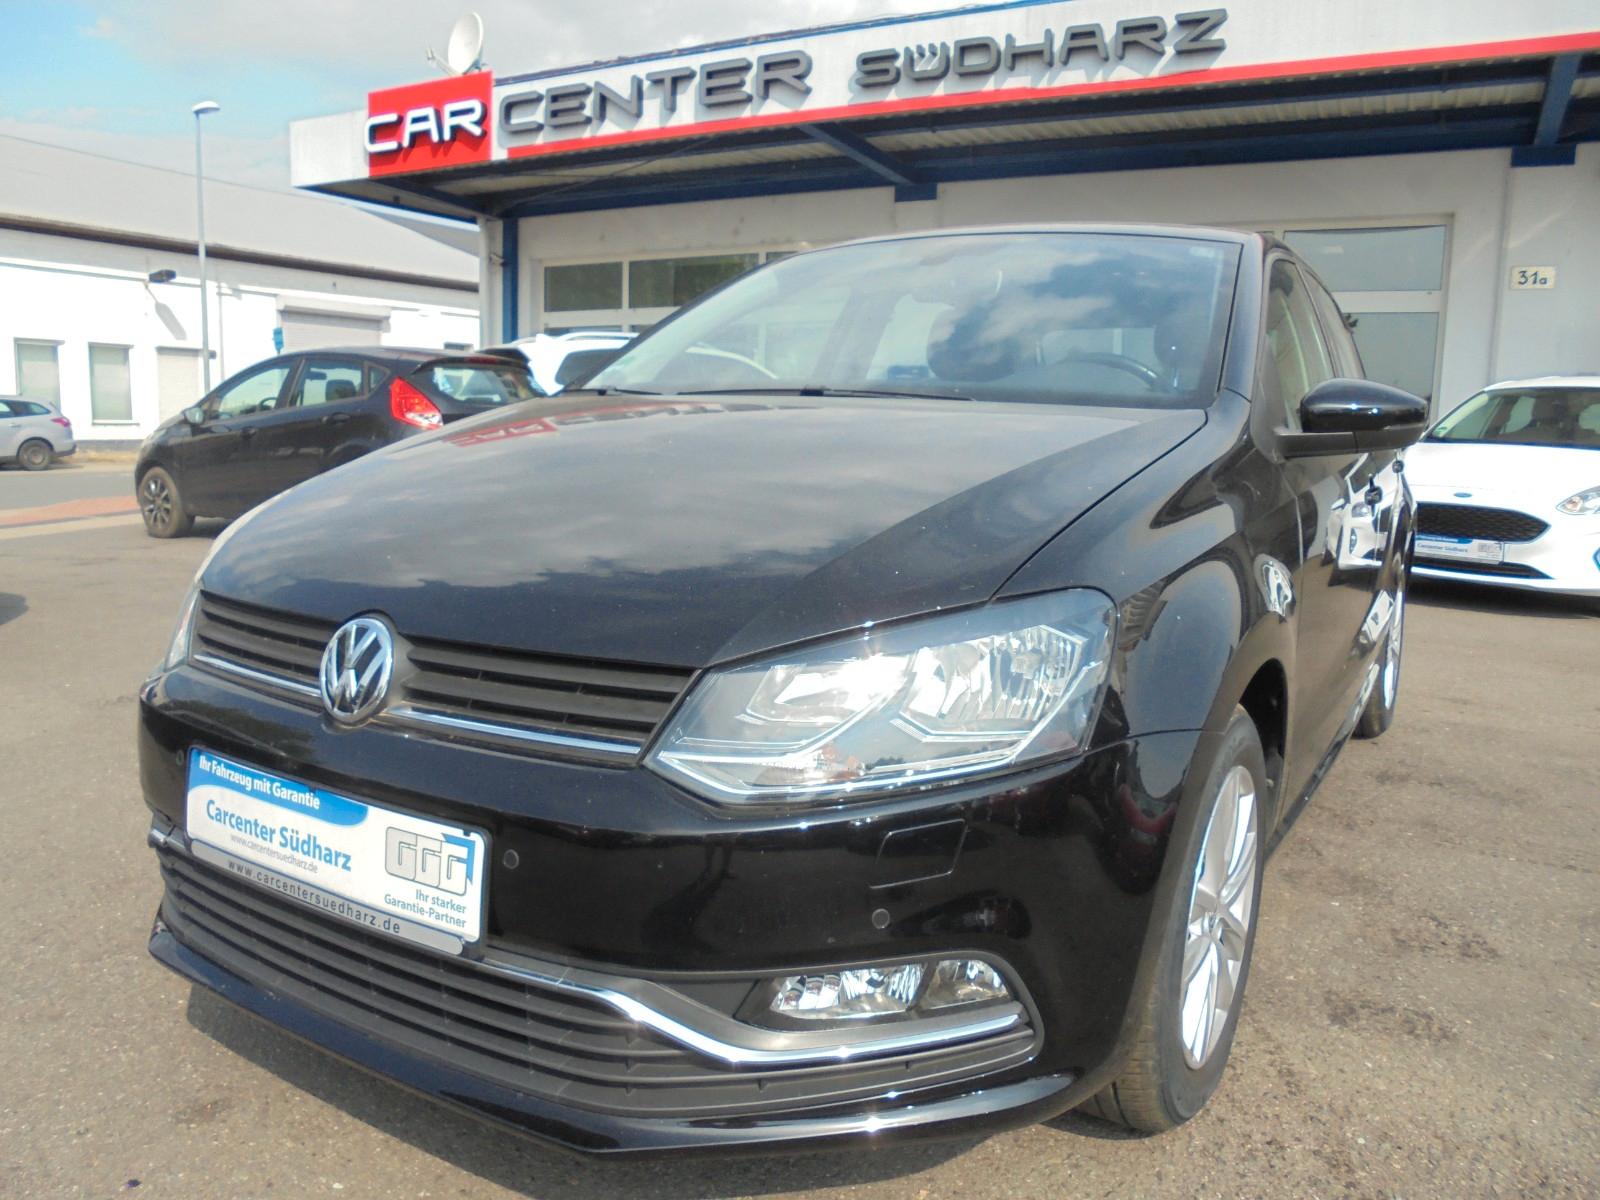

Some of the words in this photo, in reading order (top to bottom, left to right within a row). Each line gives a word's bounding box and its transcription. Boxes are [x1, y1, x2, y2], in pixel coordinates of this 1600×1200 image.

[364, 99, 487, 154] CAR
[499, 49, 813, 134] CENTER
[856, 8, 1228, 88] SÜDHARZ
[1518, 270, 1548, 285] 31a
[199, 755, 212, 773] Ihr
[212, 760, 252, 790] Fahrzeug
[254, 778, 271, 794] mit
[272, 782, 320, 810] Garantie
[206, 799, 276, 843] Carcenter
[279, 826, 352, 871] Südharz
[230, 834, 318, 873] www.carcentersuedharz.de
[228, 860, 400, 933] www.carcentersuedharz.de
[384, 893, 467, 928] Garantie-Partner
[415, 889, 430, 902] Ihr
[431, 895, 467, 914] starker
